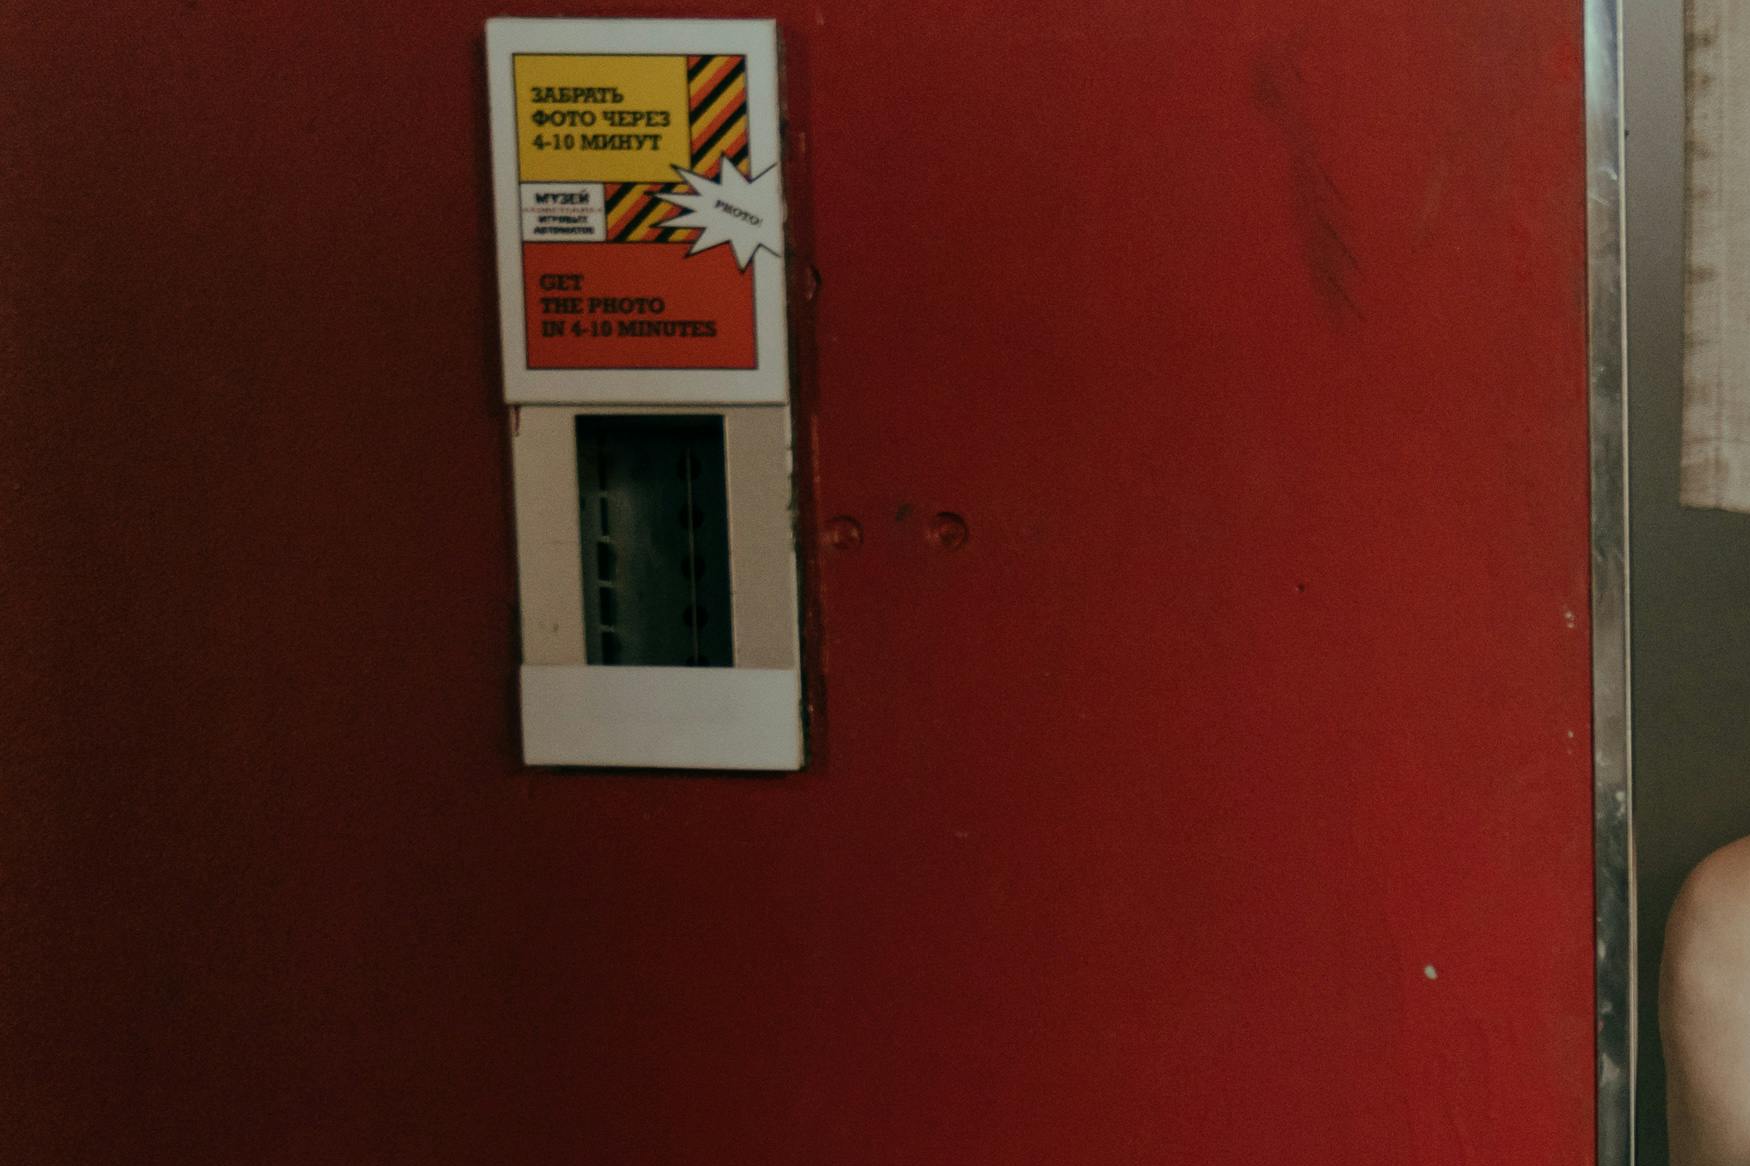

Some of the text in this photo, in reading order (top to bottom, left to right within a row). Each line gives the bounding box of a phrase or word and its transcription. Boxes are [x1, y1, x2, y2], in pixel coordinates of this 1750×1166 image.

[531, 87, 624, 104] ЗАБРАТЬ
[532, 110, 671, 127] ФОТО ЧЕРЕЗ
[533, 134, 662, 151] 4-10 МИНУТ
[540, 273, 584, 291] GET
[541, 297, 665, 314] THE PHOTO
[541, 320, 717, 338] IN 4-10 MINUTES
